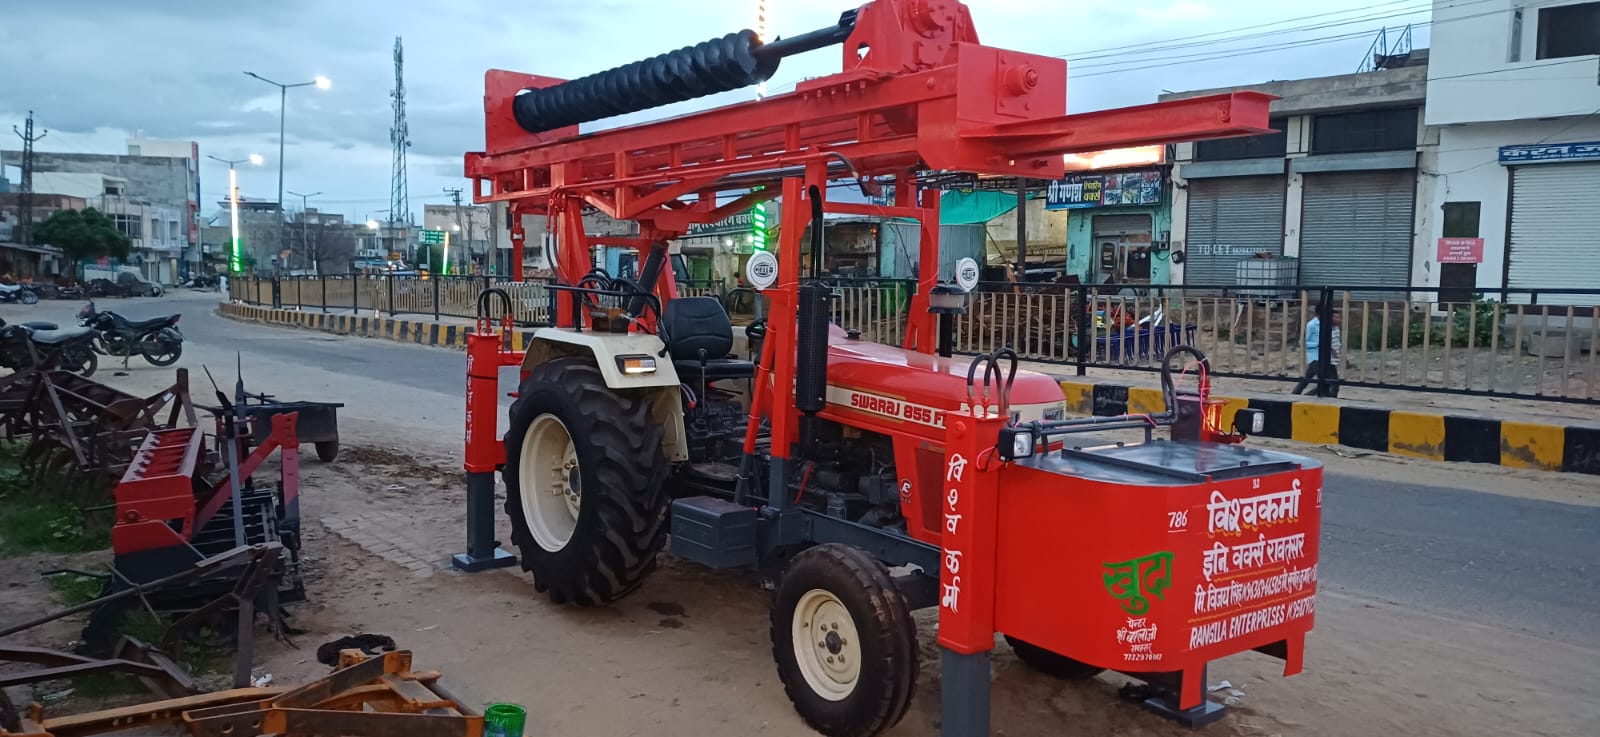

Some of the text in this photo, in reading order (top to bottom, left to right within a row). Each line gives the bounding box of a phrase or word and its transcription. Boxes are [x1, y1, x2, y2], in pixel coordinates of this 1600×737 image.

[1047, 178, 1083, 203] श्री गणेश
[903, 405, 931, 423] 855
[1167, 509, 1188, 528] 786
[1207, 478, 1301, 534] विश्वकर्मा
[1189, 620, 1227, 651] RANGILA
[1229, 603, 1286, 639] ENTERPRISES
